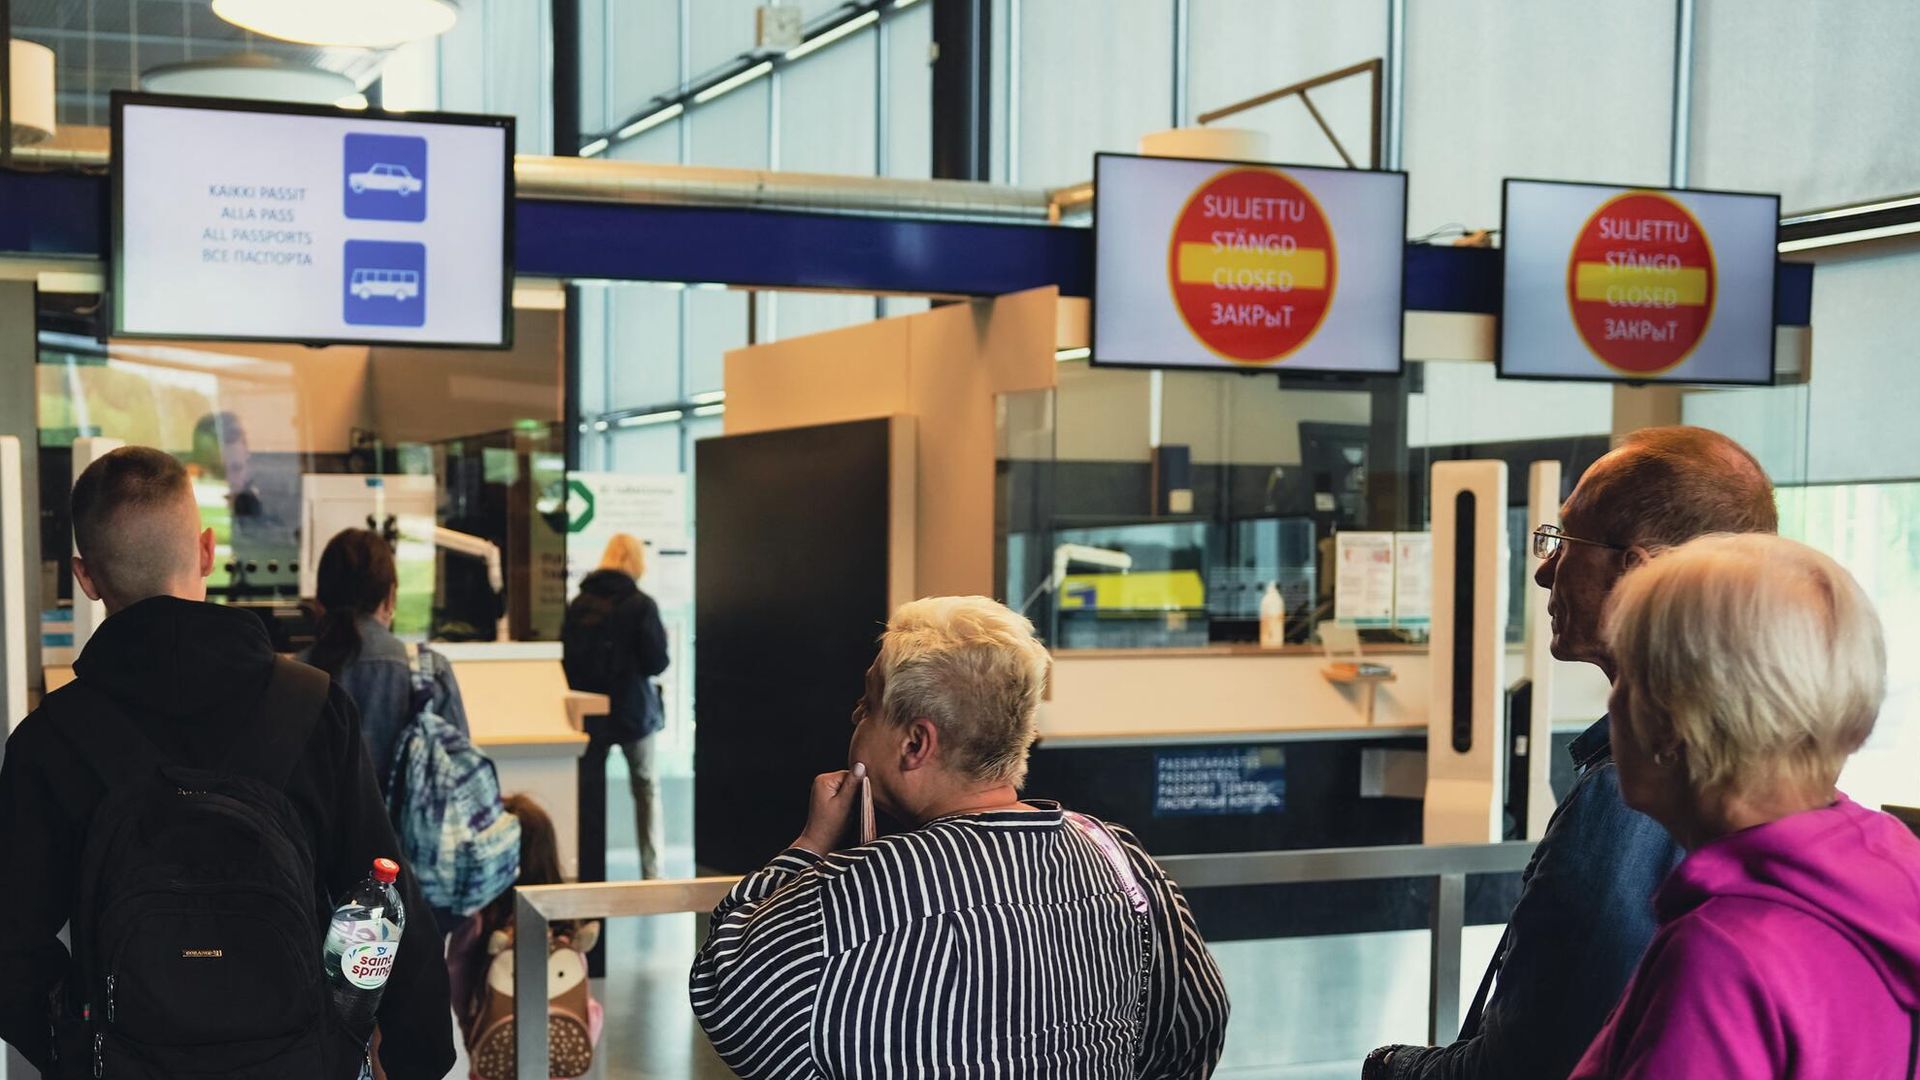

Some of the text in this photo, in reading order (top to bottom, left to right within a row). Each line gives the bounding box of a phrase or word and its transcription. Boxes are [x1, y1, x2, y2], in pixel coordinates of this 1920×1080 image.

[208, 184, 306, 200] KAIKKI PASSIT
[221, 207, 295, 222] ALLA PASS
[1202, 194, 1306, 223] SULJETTU
[202, 227, 313, 245] ALL PASSPORTS
[1598, 217, 1690, 243] SULJETTU
[1211, 228, 1297, 256] STÄNGD
[202, 248, 313, 266] ВСЕ ПАСПОРТА
[1605, 248, 1681, 274] STÄNGD
[1212, 267, 1295, 293] CLOSED
[1606, 285, 1677, 309] CLOSED
[1158, 782, 1216, 796] PASSPORT
[360, 954, 392, 966] saint
